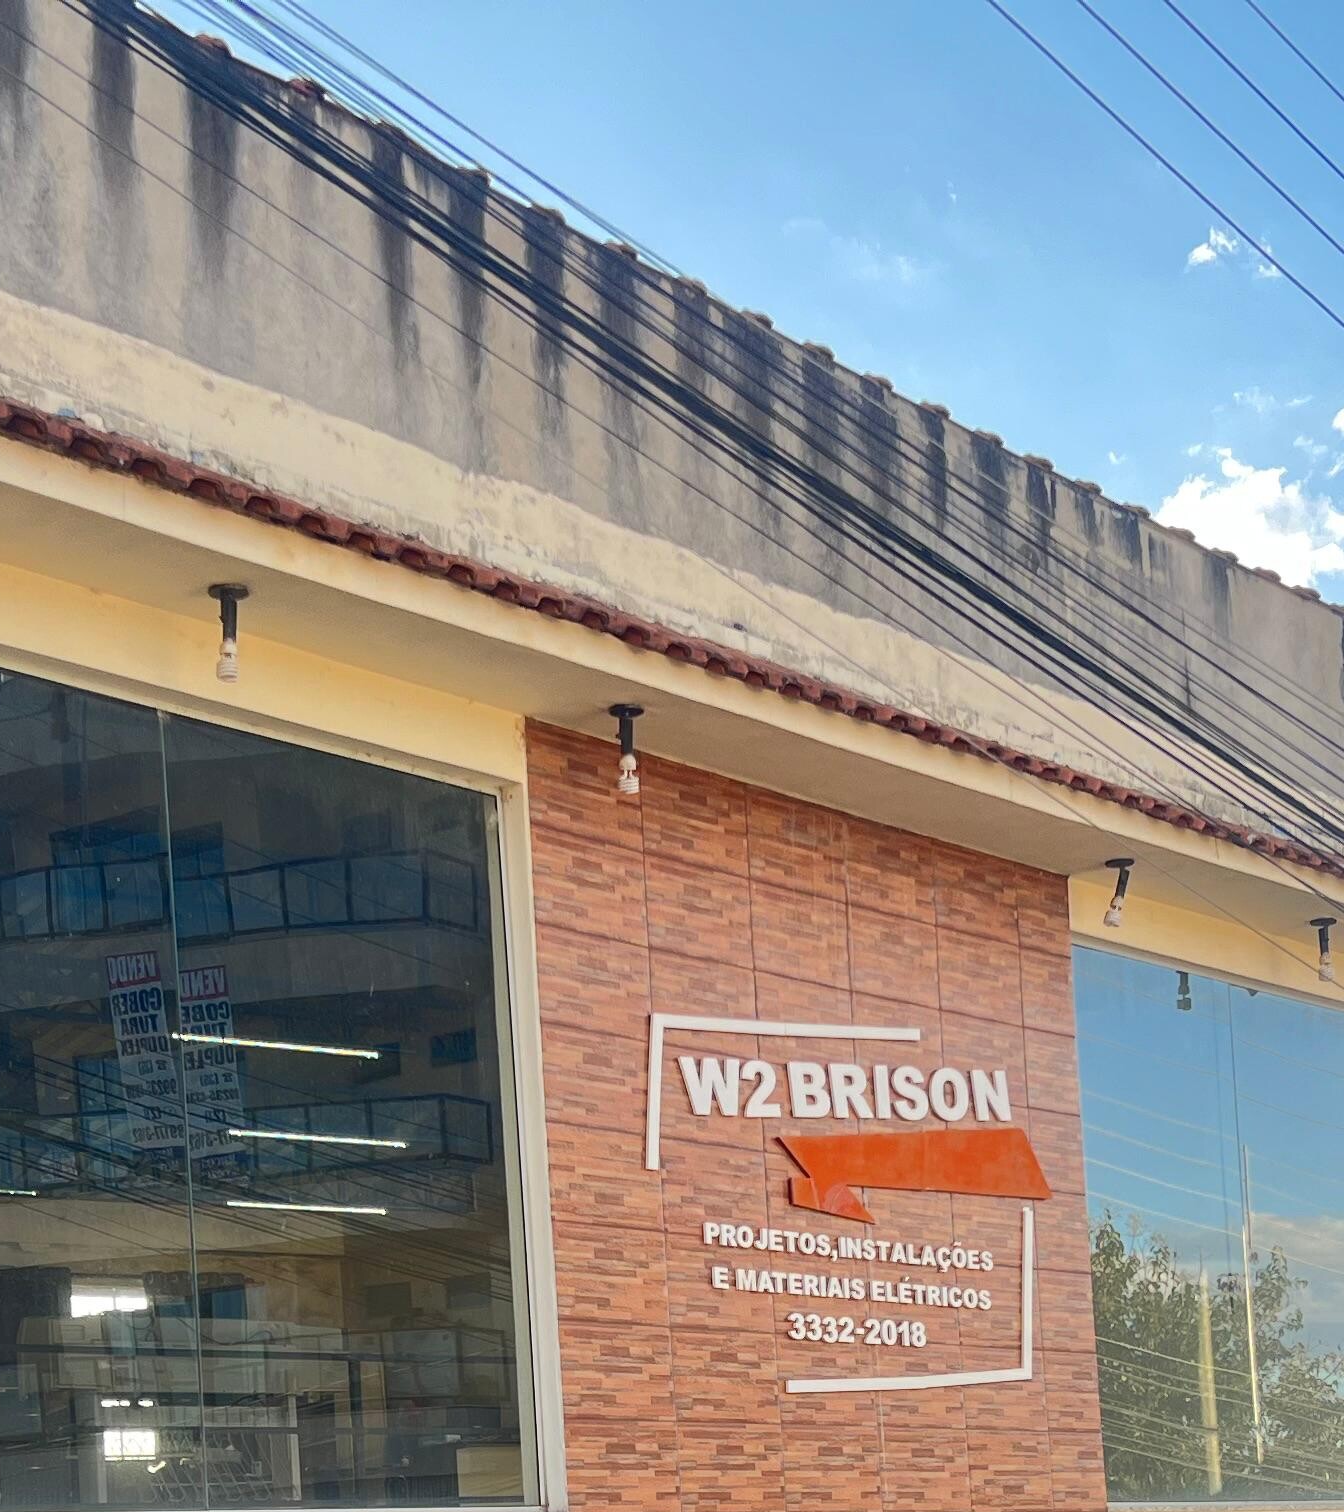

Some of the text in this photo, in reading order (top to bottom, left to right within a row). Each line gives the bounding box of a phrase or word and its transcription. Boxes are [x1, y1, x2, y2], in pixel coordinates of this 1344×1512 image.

[677, 1056, 1011, 1122] W2 BRISON
[711, 1266, 993, 1311] E MATERIAIS ELÉTRICOS
[787, 1312, 928, 1349] 3332-2018
